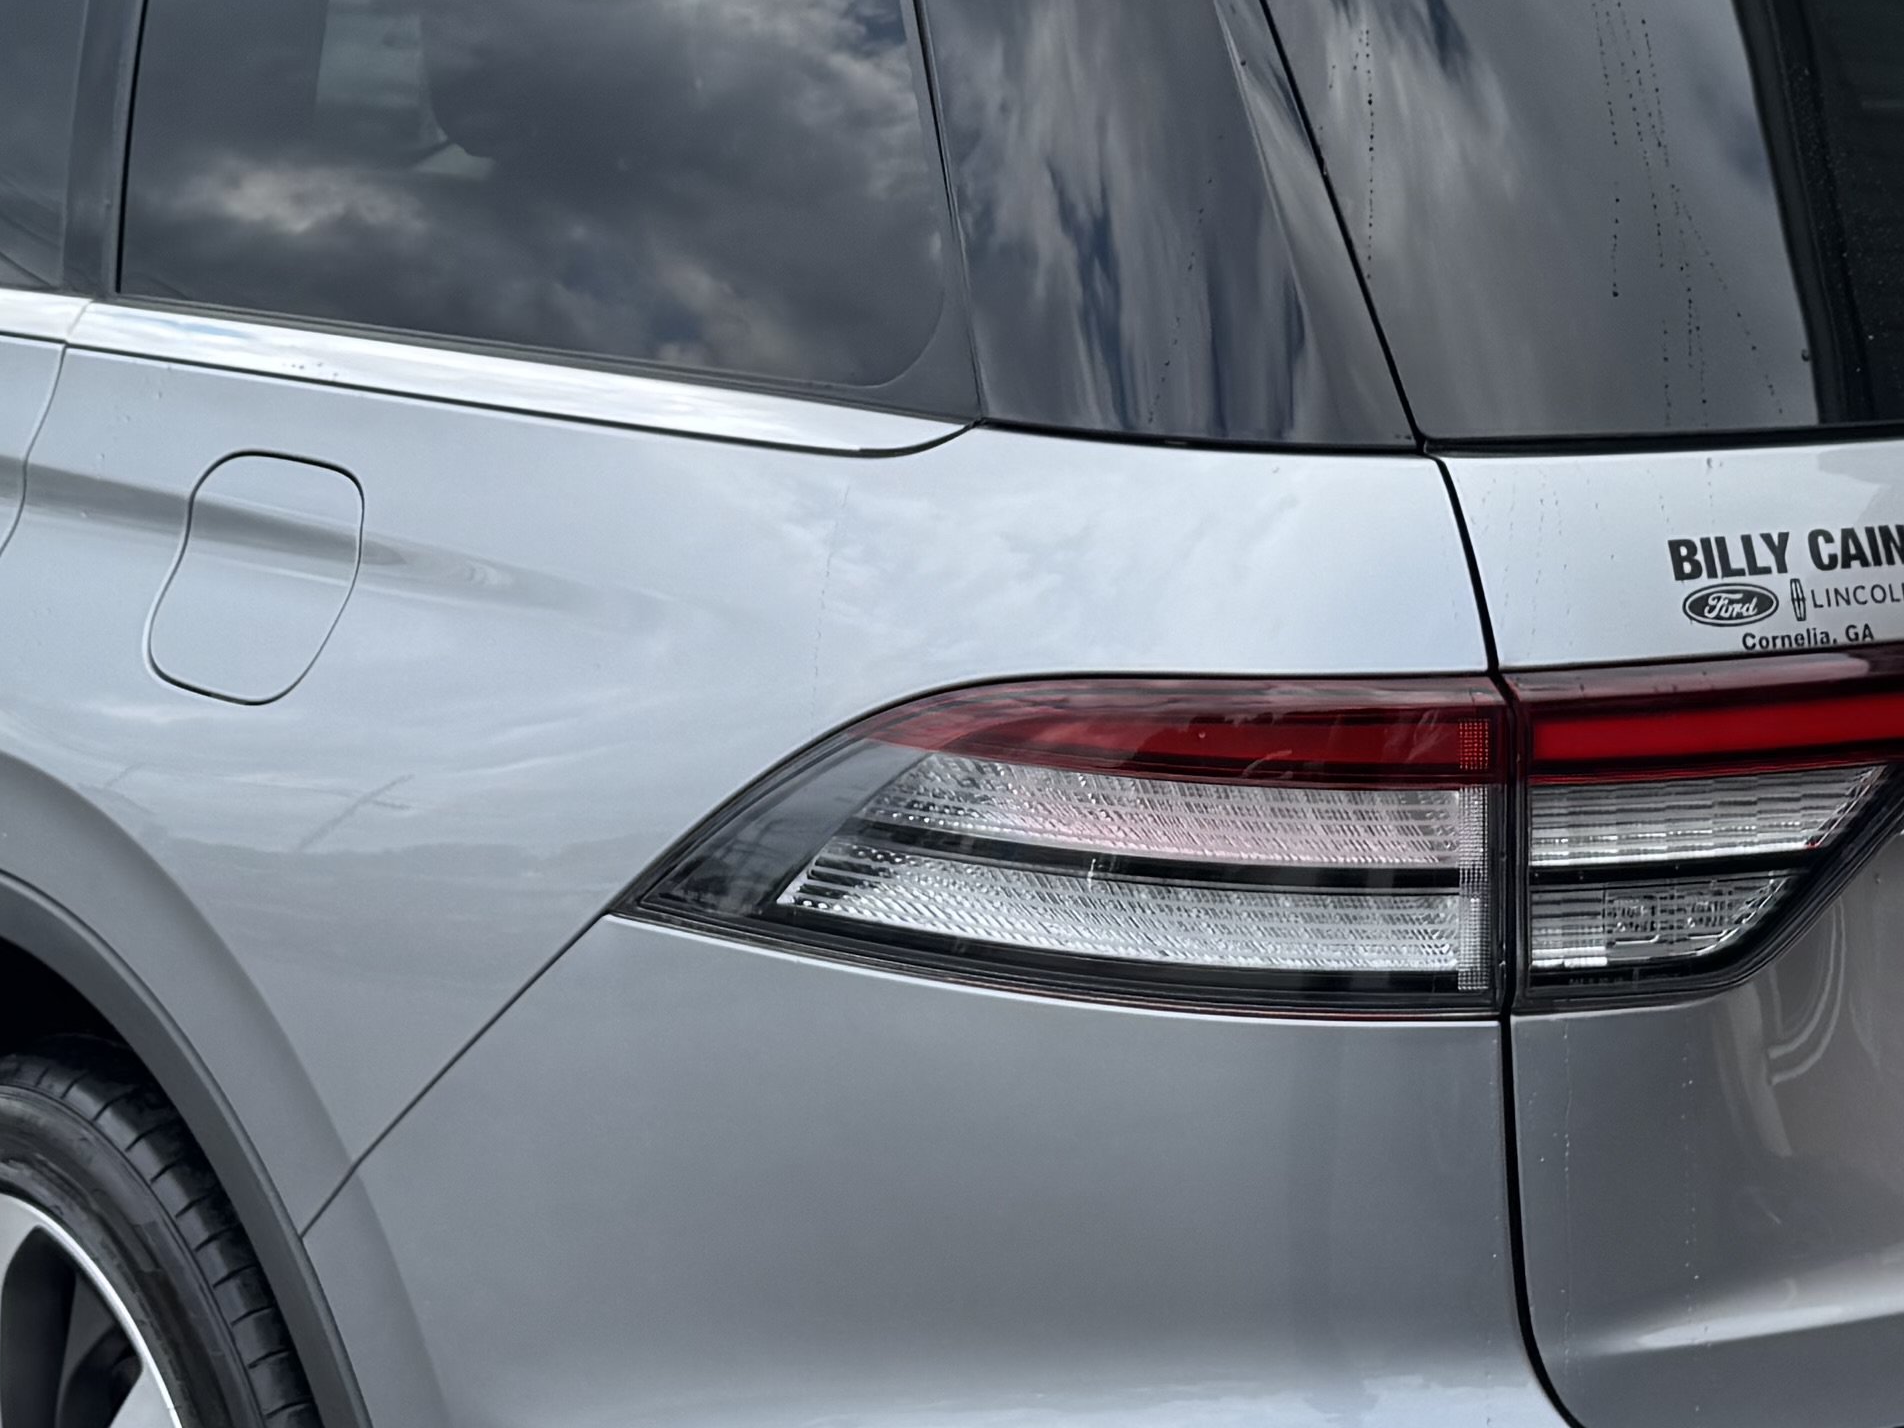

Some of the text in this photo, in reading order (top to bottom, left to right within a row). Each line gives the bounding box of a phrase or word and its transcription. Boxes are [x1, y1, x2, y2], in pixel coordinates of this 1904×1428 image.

[1668, 532, 1790, 581] BILLY
[1742, 624, 1874, 650] Cornelia, GA
